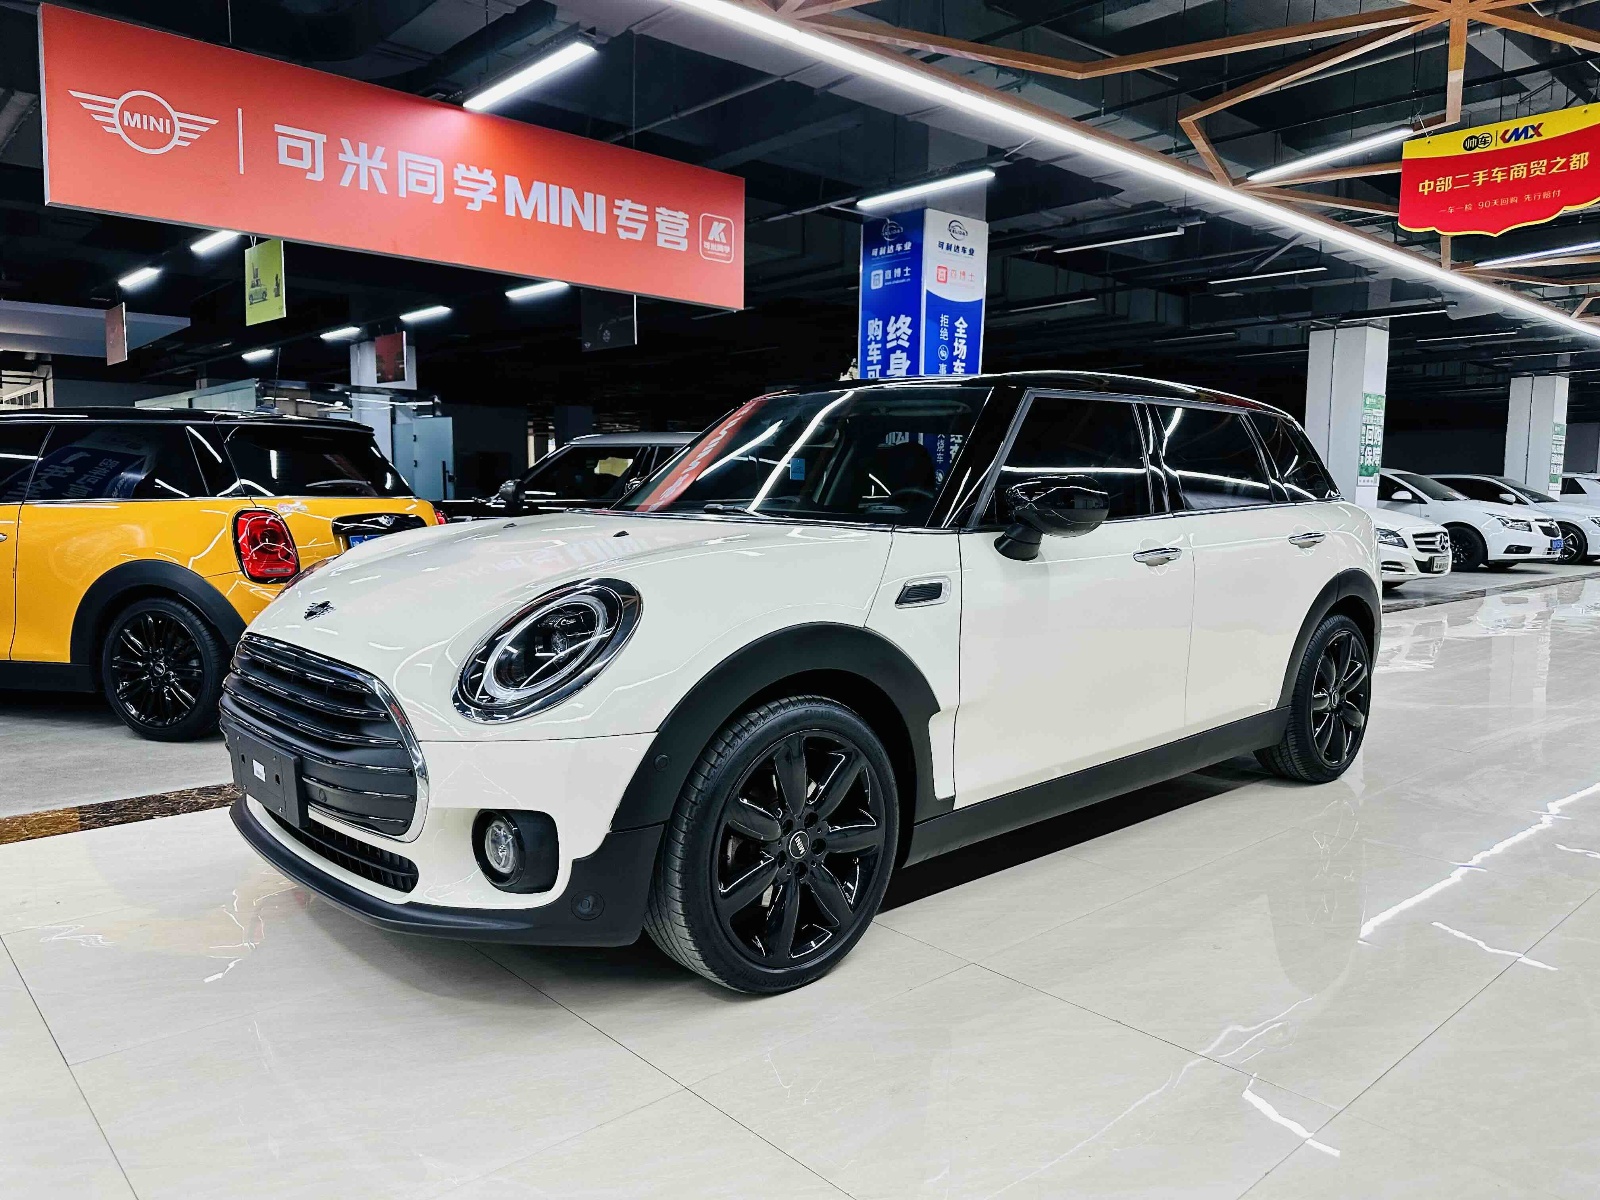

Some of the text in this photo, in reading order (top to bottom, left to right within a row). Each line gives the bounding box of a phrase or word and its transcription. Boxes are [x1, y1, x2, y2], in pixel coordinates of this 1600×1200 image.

[123, 111, 171, 135] MINI
[275, 123, 690, 252] 可米同学MINI专营
[1418, 152, 1590, 196] 中部二手车商贸之都
